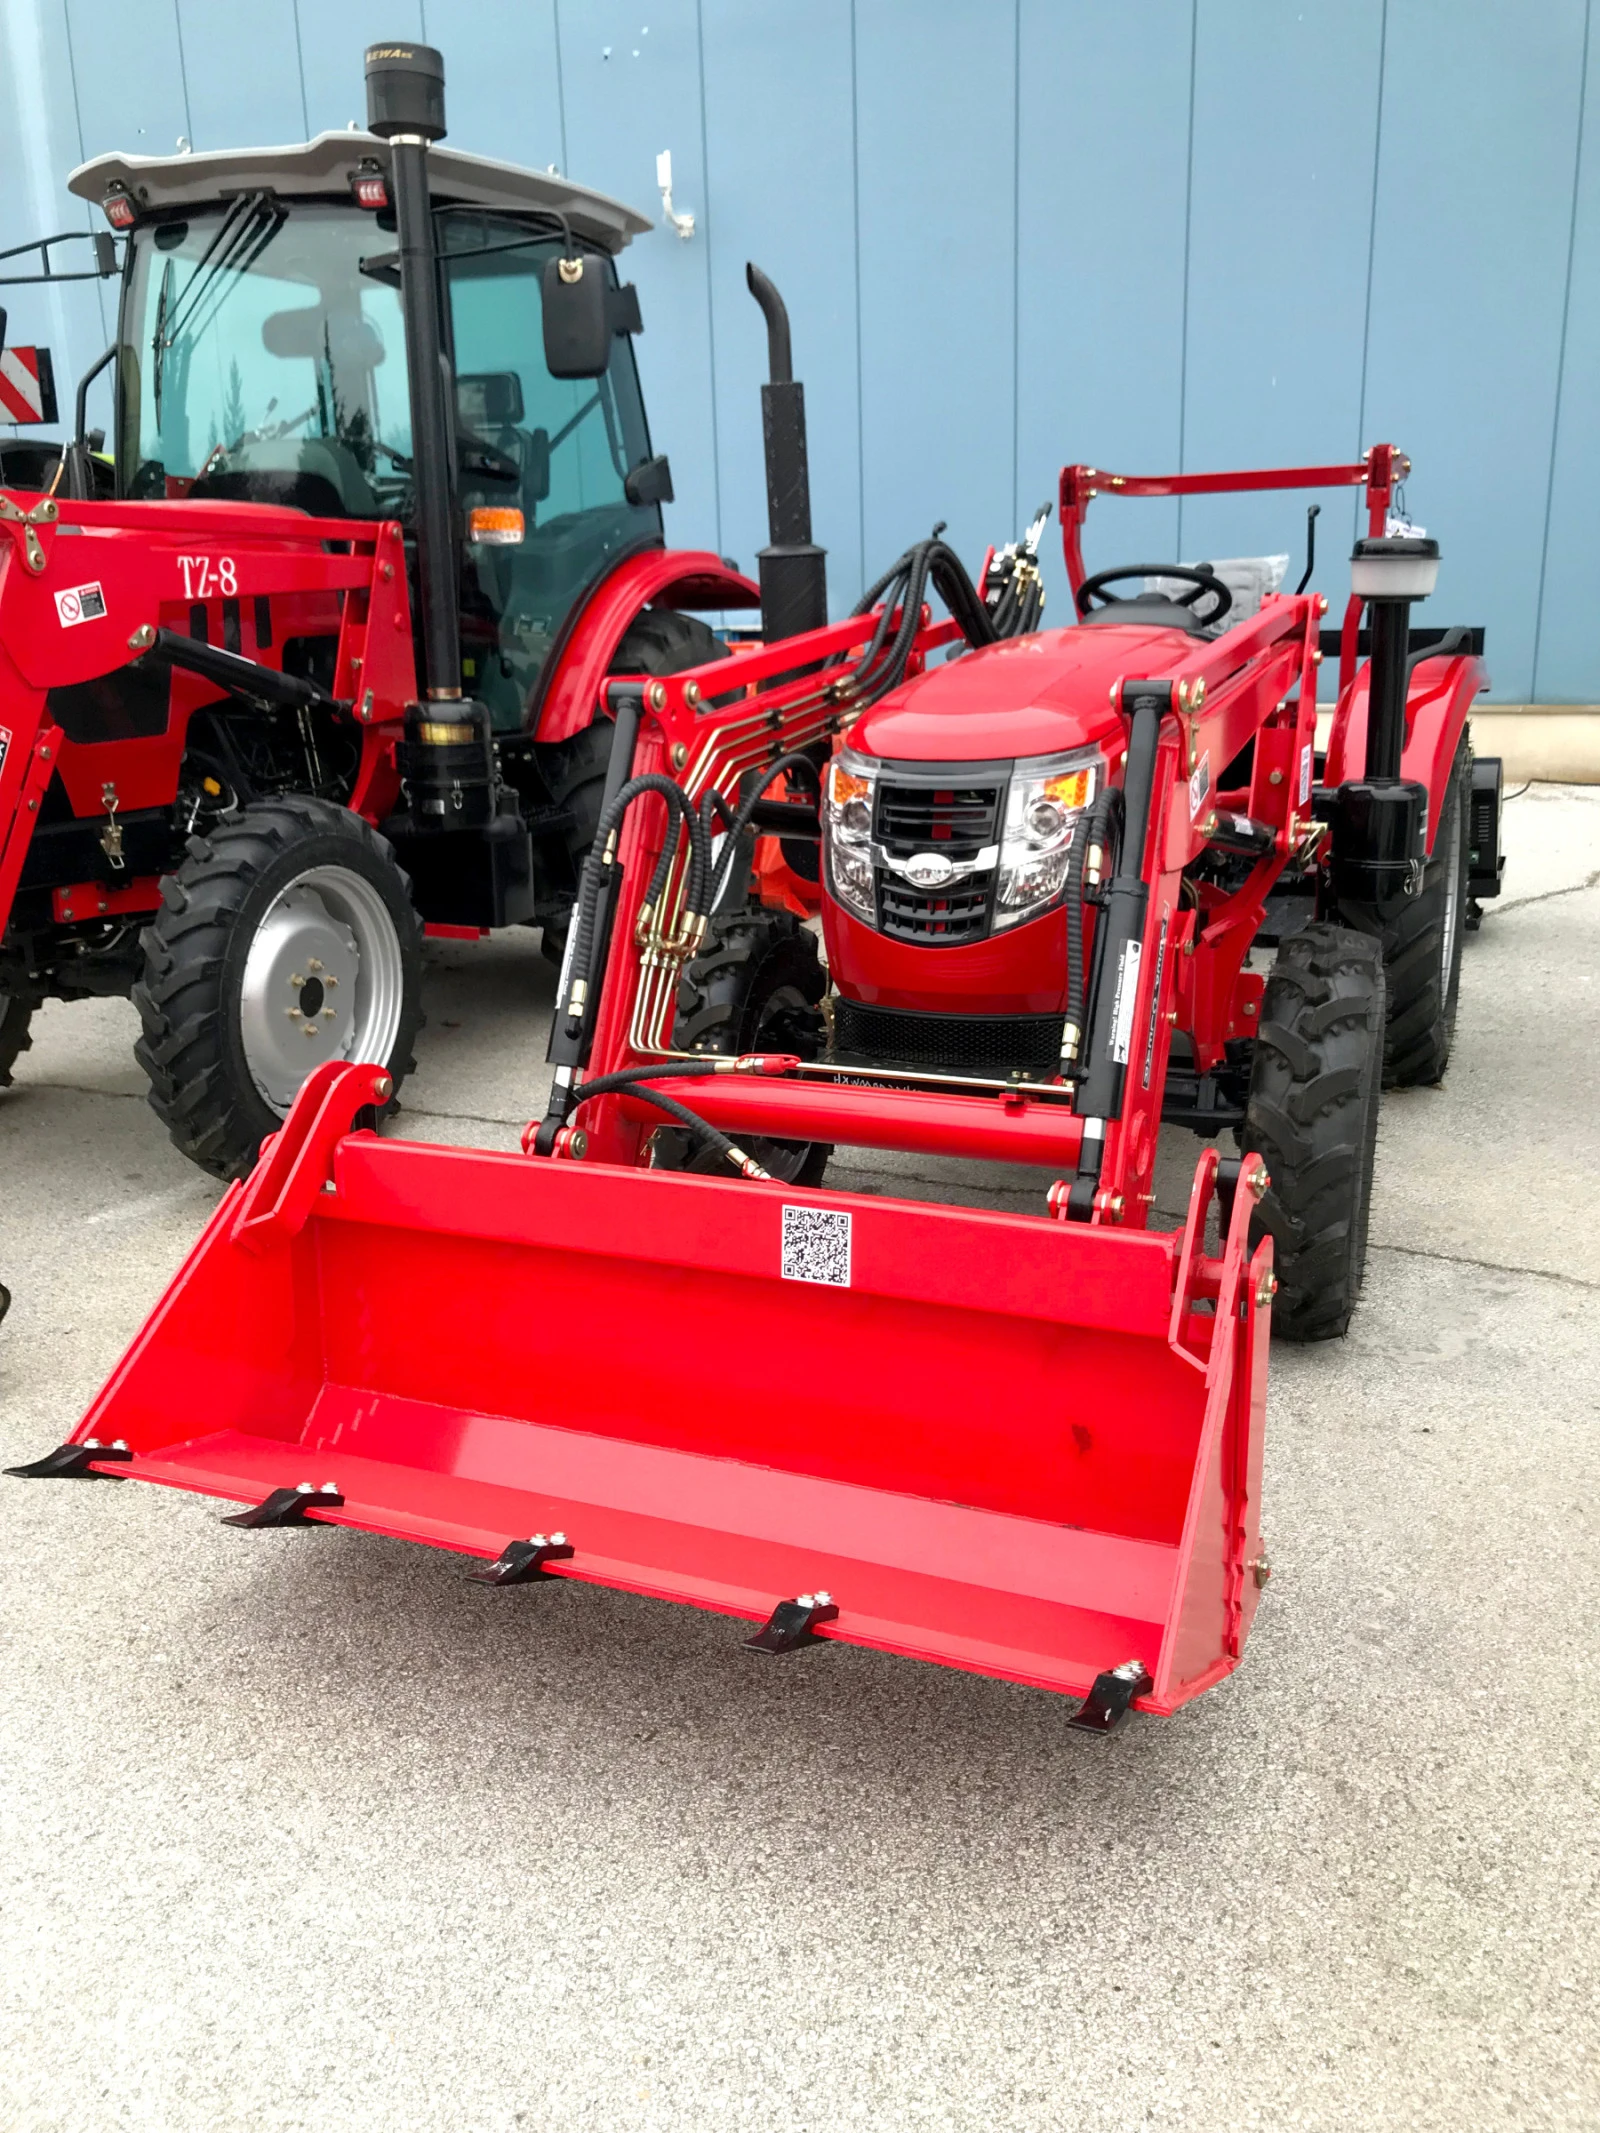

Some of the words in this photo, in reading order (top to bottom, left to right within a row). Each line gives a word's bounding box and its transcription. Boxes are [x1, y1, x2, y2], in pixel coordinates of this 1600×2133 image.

[177, 555, 238, 599] TZ-8
[1115, 972, 1123, 999] Pressure
[1112, 1000, 1120, 1016] High
[1109, 1016, 1118, 1046] Warning!
